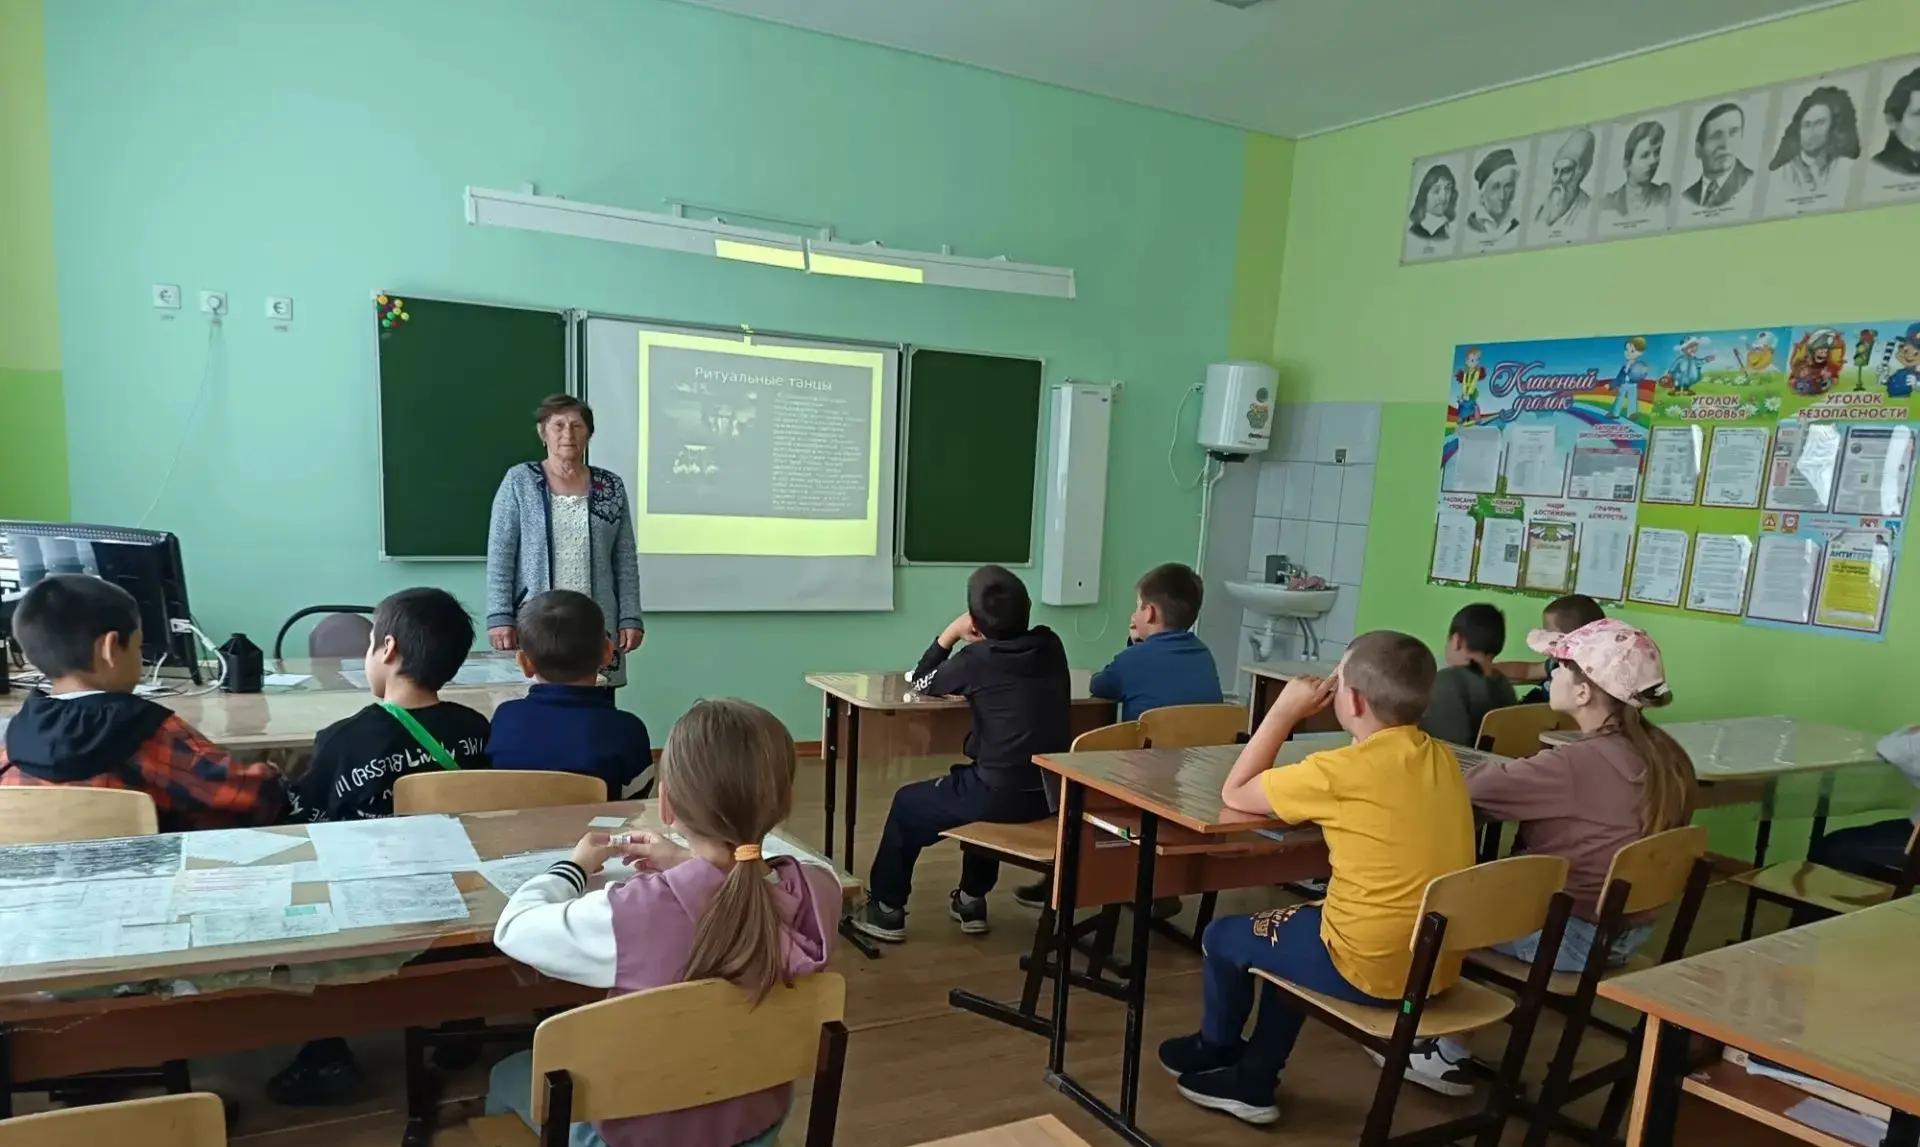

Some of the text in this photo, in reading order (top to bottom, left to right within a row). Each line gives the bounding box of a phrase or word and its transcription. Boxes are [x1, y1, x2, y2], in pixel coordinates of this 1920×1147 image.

[694, 366, 833, 391] Ритуальные танцы
[1490, 360, 1599, 397] Классный
[1692, 396, 1739, 405] УГОЛОК
[1826, 394, 1882, 404] УГОЛОК
[1499, 394, 1573, 423] уголок
[1682, 409, 1746, 419] ЗДОРОВЬЯ
[1799, 408, 1907, 419] БЕЗОПАСНОСТИ
